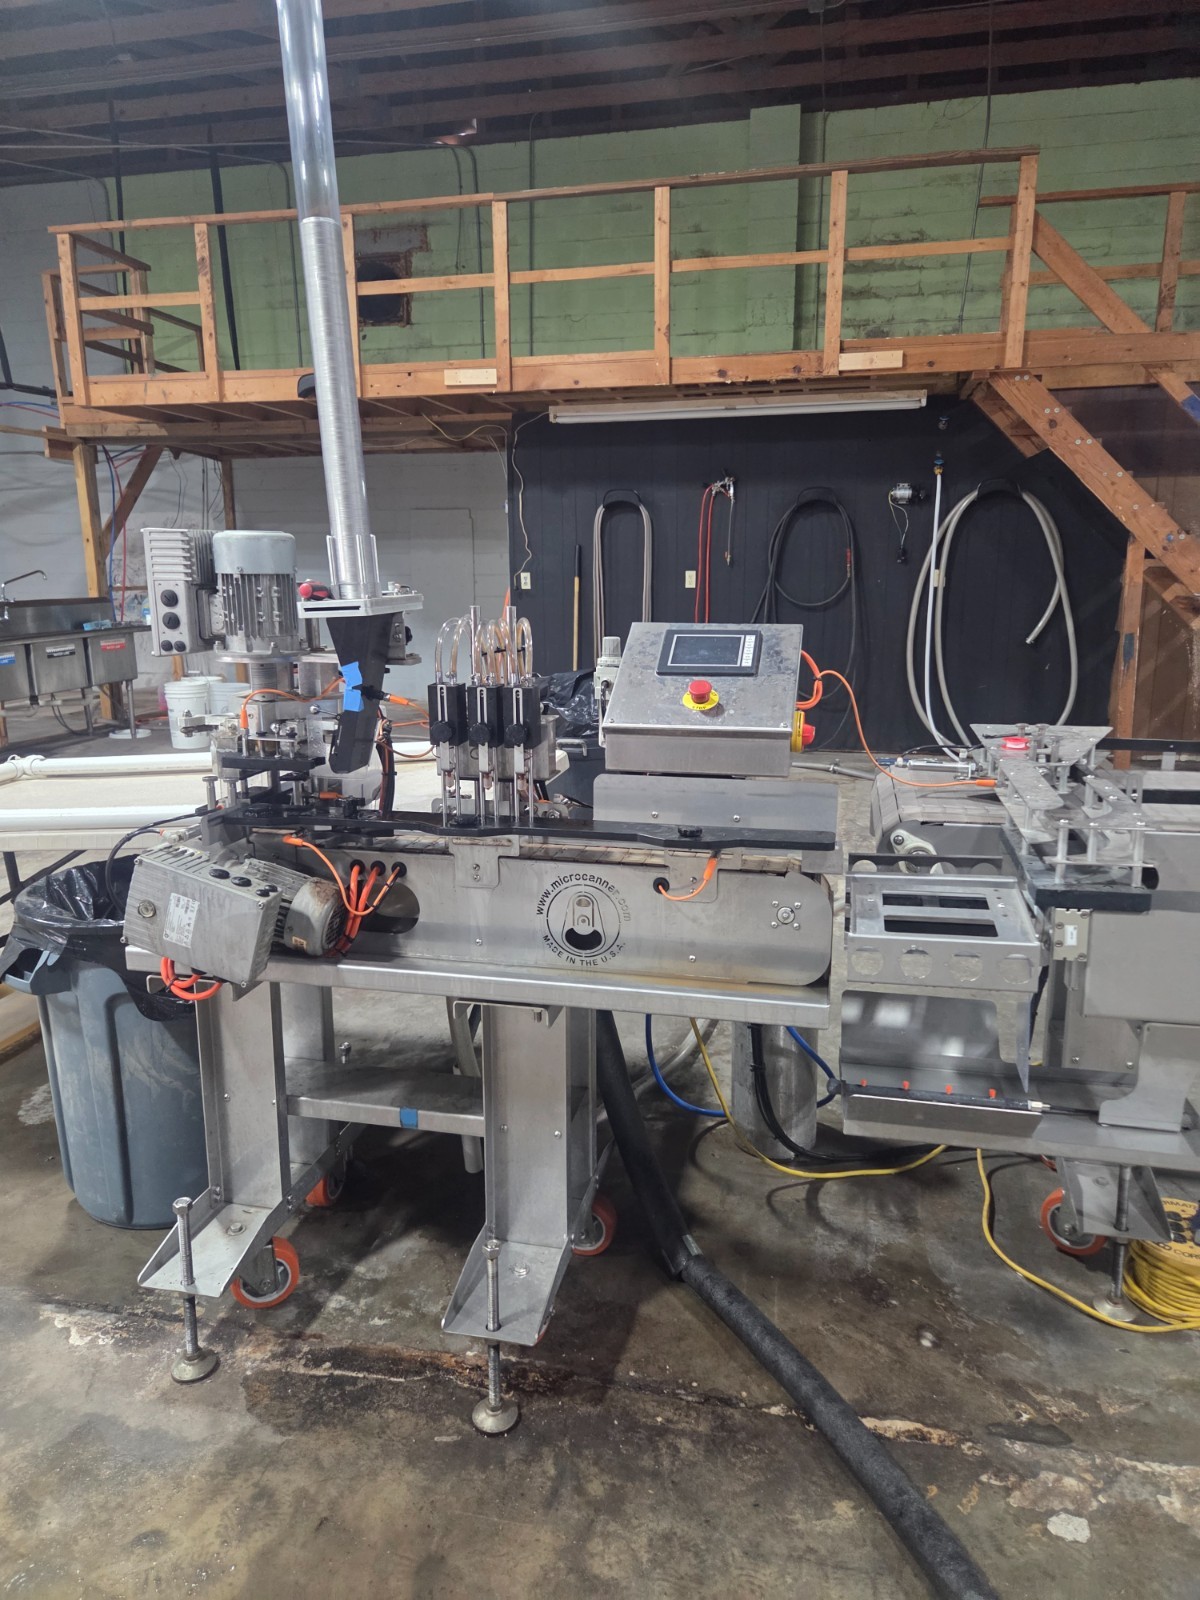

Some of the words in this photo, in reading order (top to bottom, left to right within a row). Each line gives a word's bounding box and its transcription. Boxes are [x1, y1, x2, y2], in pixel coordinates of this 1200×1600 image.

[536, 873, 631, 921] www.microcanner.com
[542, 935, 564, 958] MADE
[566, 955, 576, 964] IN
[579, 959, 599, 967] THE
